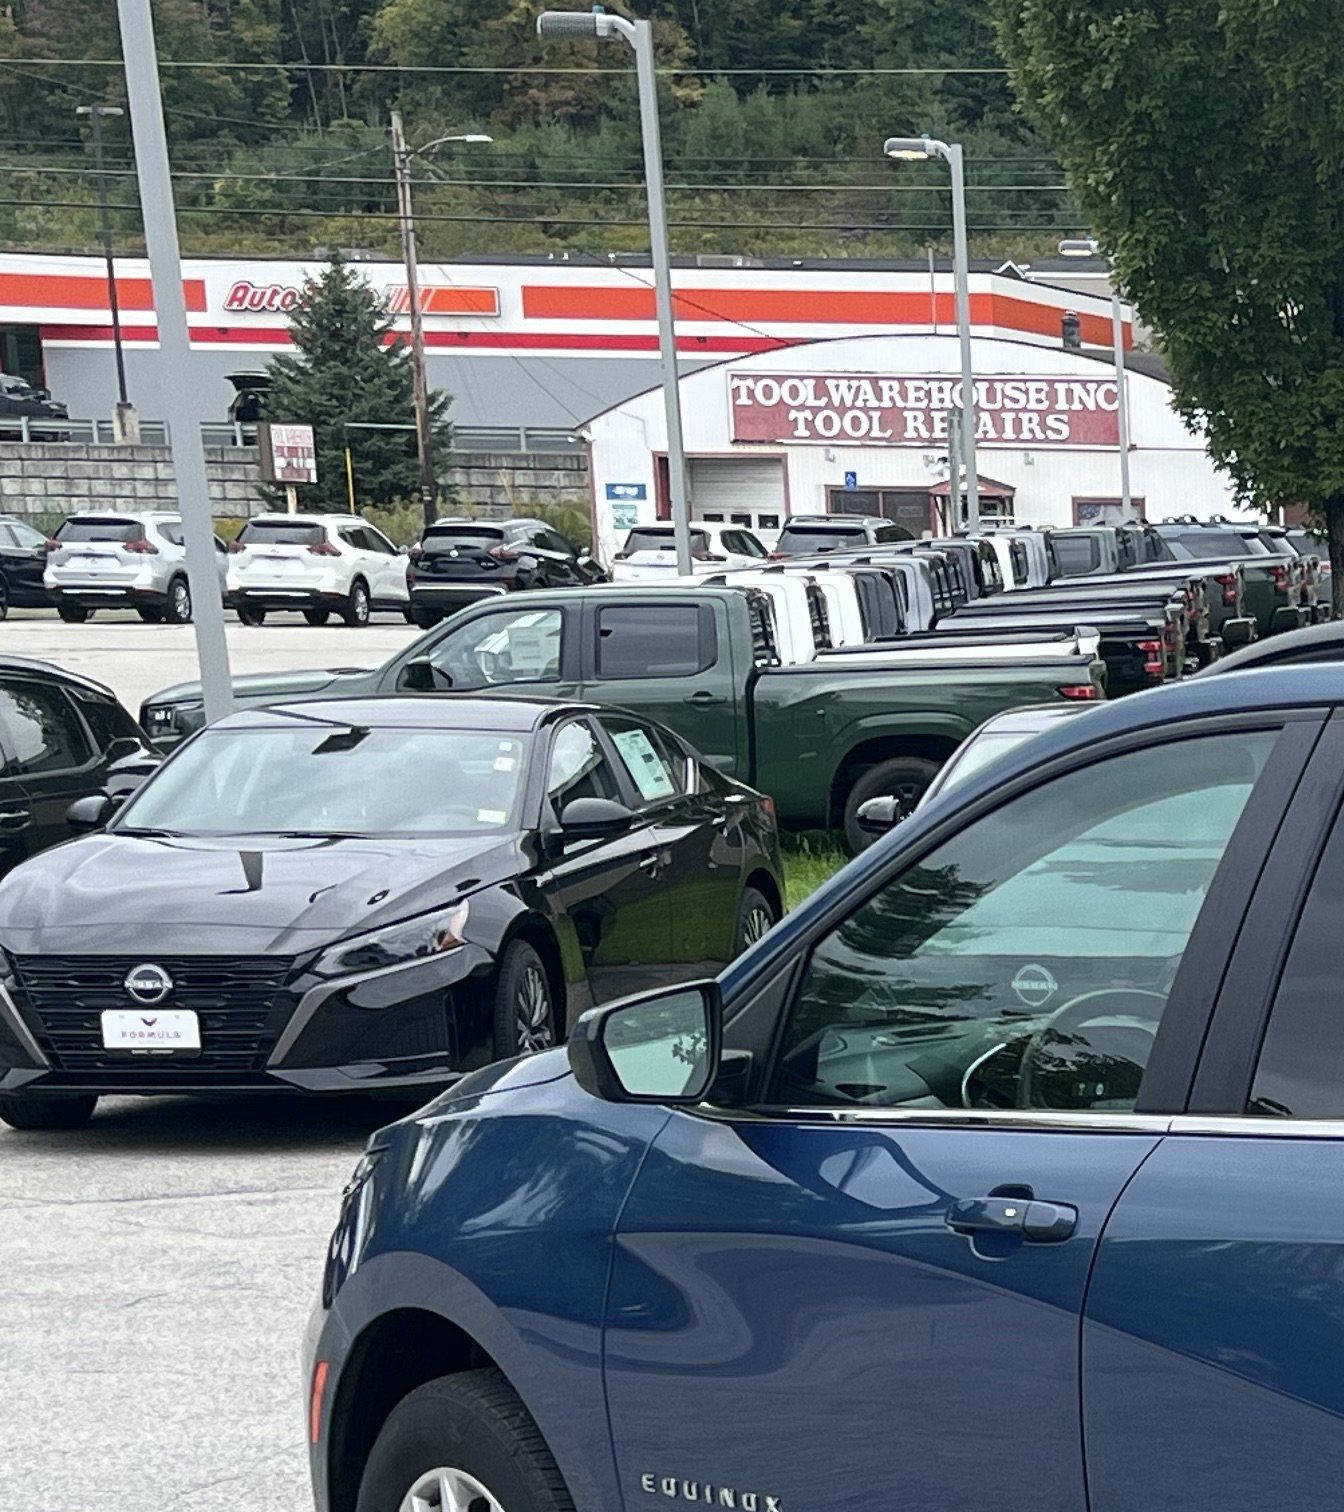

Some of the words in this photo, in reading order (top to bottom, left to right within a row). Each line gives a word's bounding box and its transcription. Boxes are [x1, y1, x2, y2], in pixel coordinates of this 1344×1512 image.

[1053, 382, 1119, 411] INC
[788, 409, 893, 439] TOOL
[902, 410, 1070, 441] REAIRS
[121, 1031, 181, 1039] FORMULA
